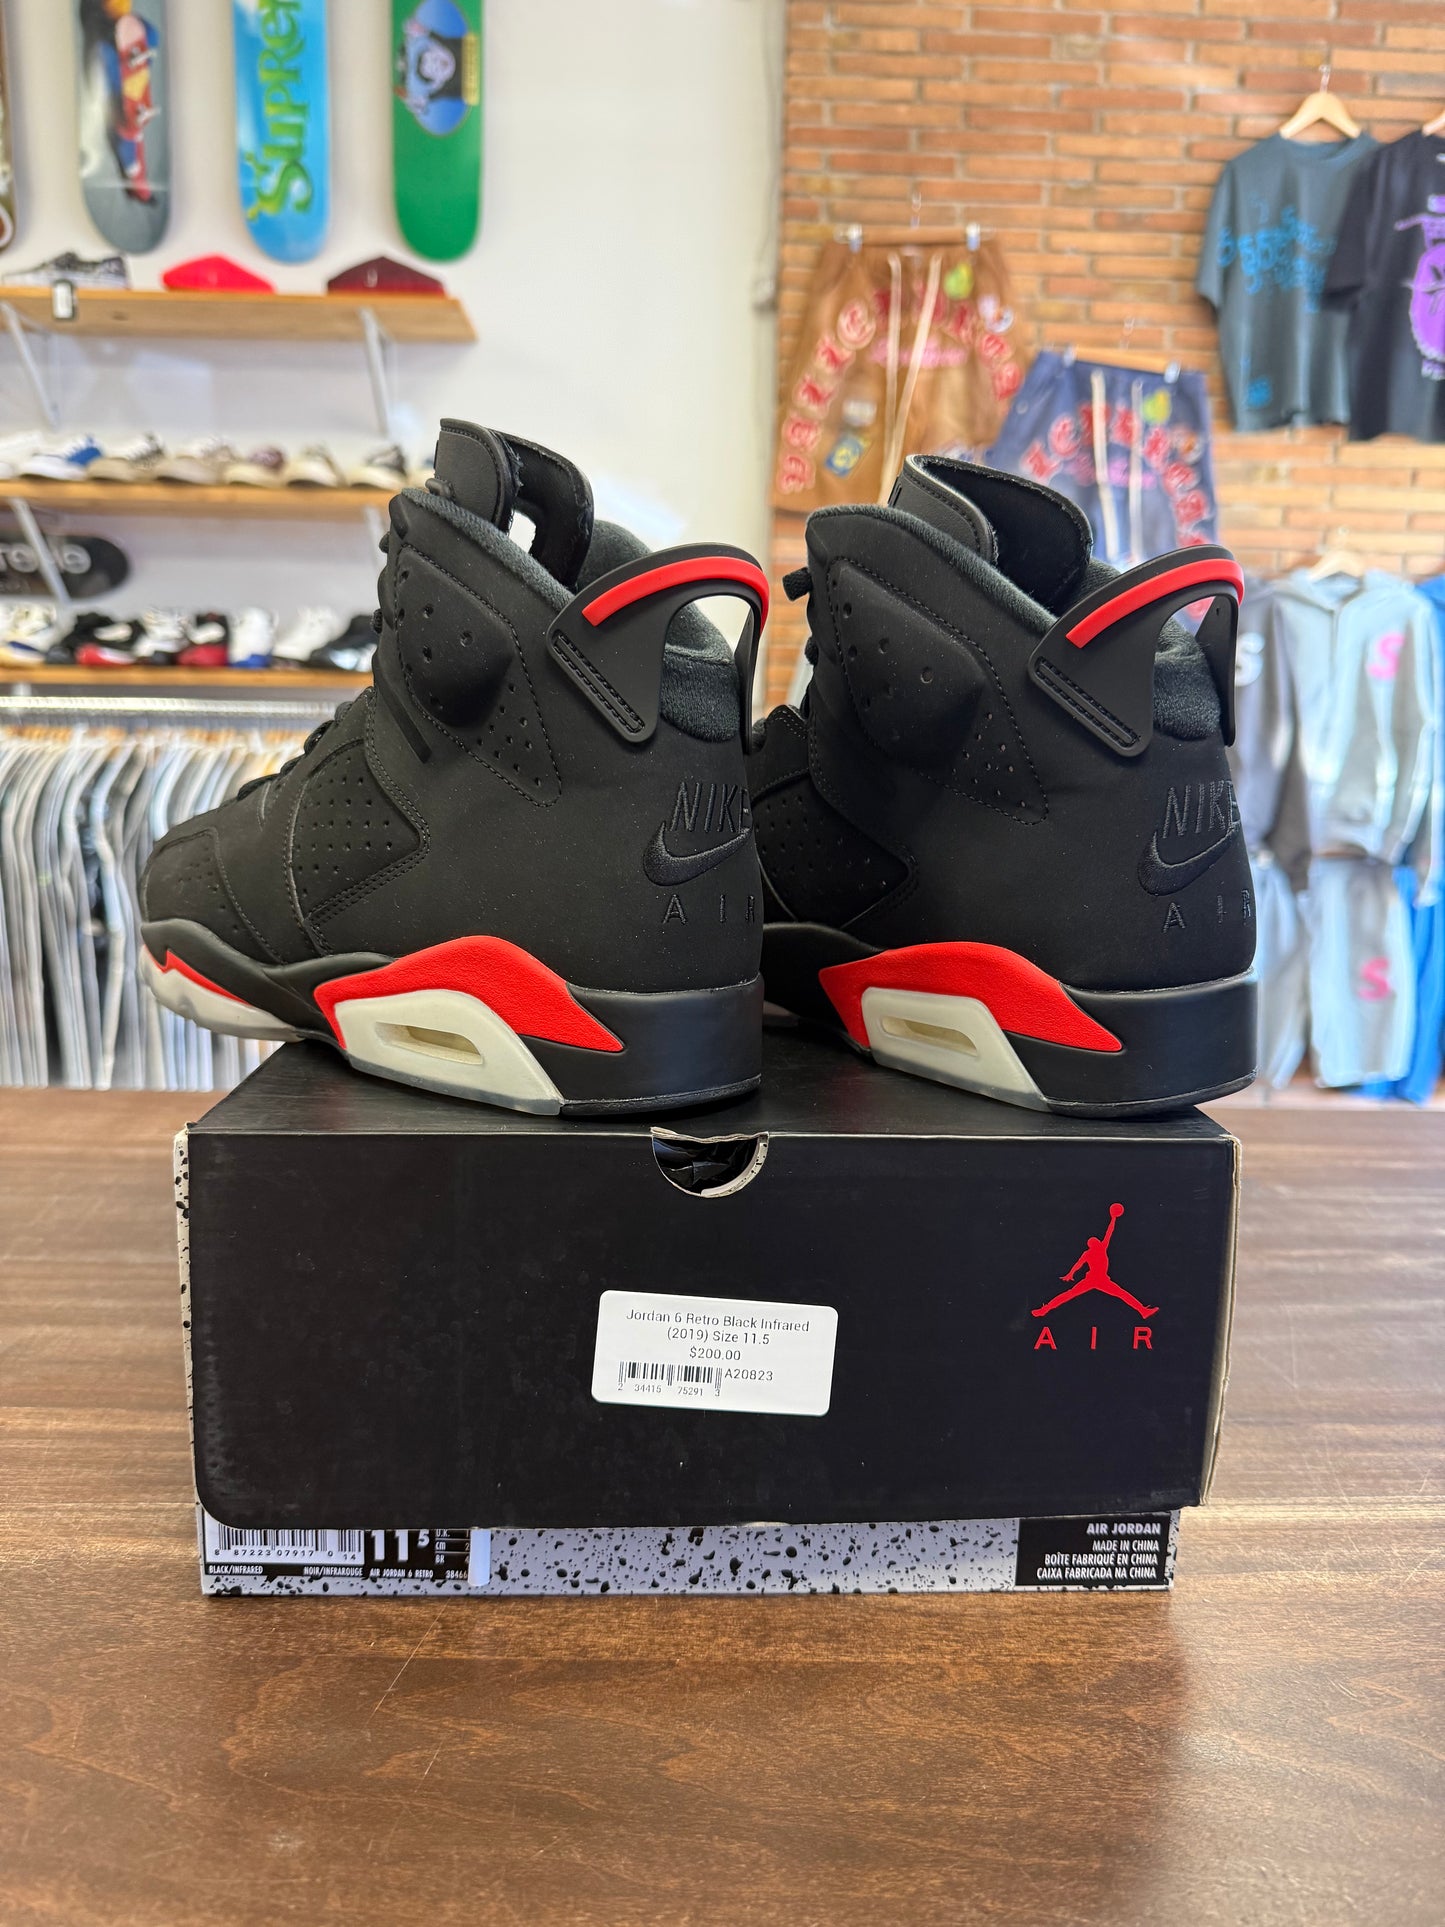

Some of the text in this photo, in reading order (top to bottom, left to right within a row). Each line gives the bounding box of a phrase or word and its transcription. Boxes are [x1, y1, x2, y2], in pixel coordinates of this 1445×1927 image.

[1162, 779, 1242, 839] NIKE
[626, 1309, 810, 1332] Jordan 6 Retro Black Infrared
[667, 1327, 770, 1345] (2019) Size 11.5
[1034, 1326, 1153, 1350] AIR
[689, 1346, 742, 1361] $200.00
[724, 1368, 774, 1381] A20823
[617, 1382, 721, 1397] 2 34415 75291 3
[1086, 1523, 1162, 1535] AIR JORDAN
[371, 1529, 430, 1562] 11 5
[435, 1541, 446, 1551] CM
[1092, 1540, 1160, 1552] MADE IN CHINA
[435, 1554, 445, 1564] BR
[1044, 1552, 1158, 1565] BOÎTE FABRIQUÉ EN CHINA
[208, 1565, 263, 1574] BLACK/INFRARED
[303, 1566, 363, 1576] NOIR/INFRAROUGE
[369, 1568, 433, 1578] AIR JORDAN 6 RETRO
[1036, 1567, 1157, 1579] CAIXA FABRICADA NA CHINA
